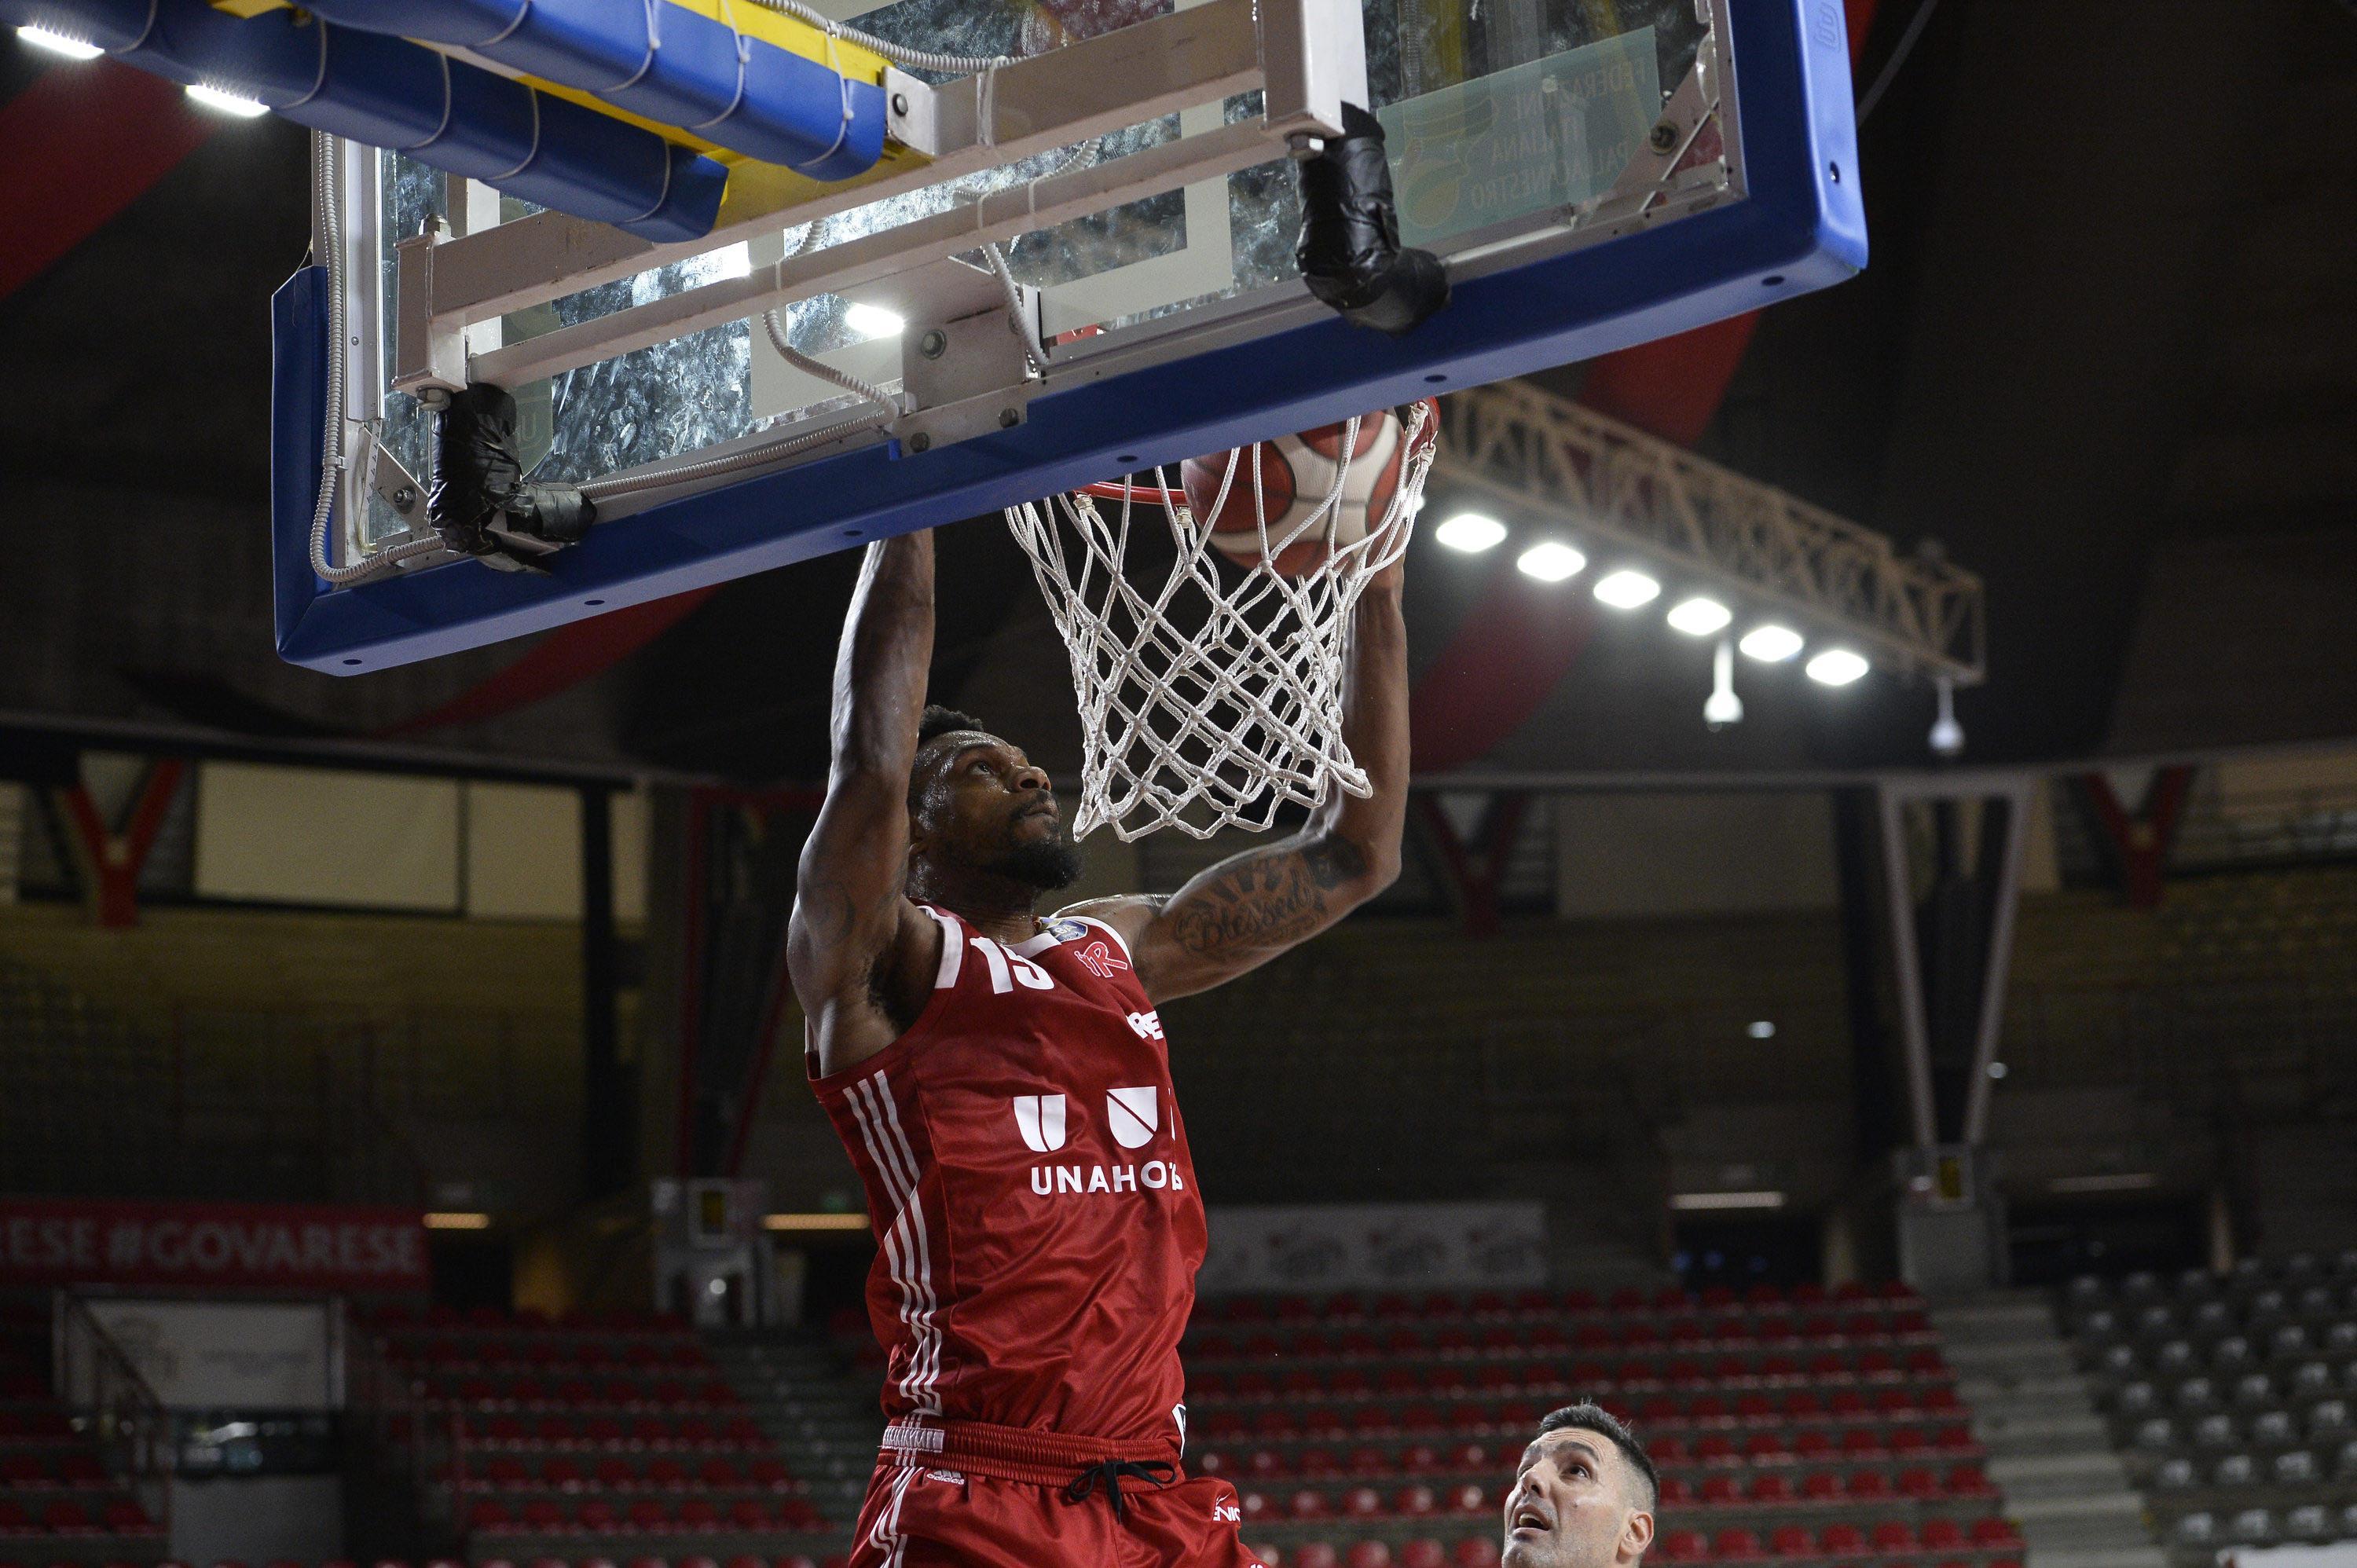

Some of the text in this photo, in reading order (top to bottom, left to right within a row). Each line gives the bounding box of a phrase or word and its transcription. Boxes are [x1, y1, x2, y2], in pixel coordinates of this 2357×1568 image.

[970, 936, 1054, 995] 15
[0, 1217, 420, 1273] ESE #GOVARESE
[927, 1474, 965, 1485] adidas
